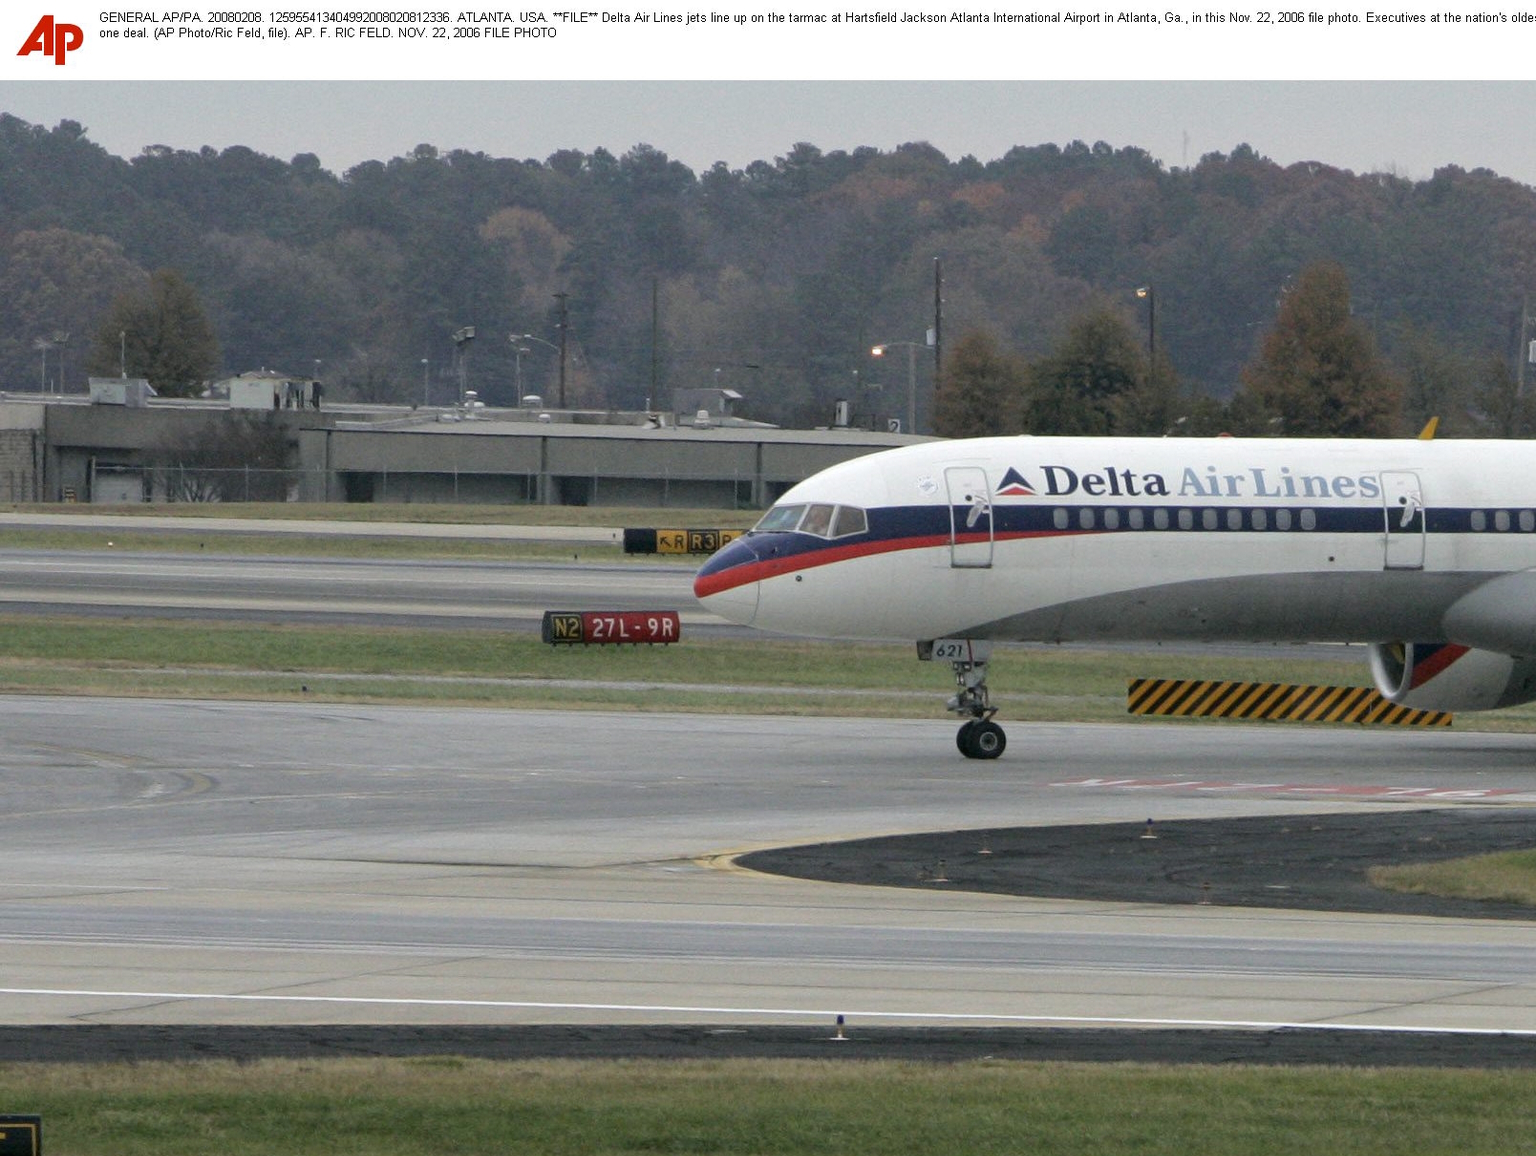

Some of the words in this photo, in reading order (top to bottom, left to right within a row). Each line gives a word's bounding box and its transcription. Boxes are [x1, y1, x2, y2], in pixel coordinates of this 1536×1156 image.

[1039, 464, 1170, 497] Delta
[1176, 465, 1245, 498] Air
[1249, 467, 1381, 499] Lines
[674, 534, 684, 549] R
[692, 534, 716, 550] R3
[554, 617, 579, 638] N2
[936, 644, 963, 658] 621
